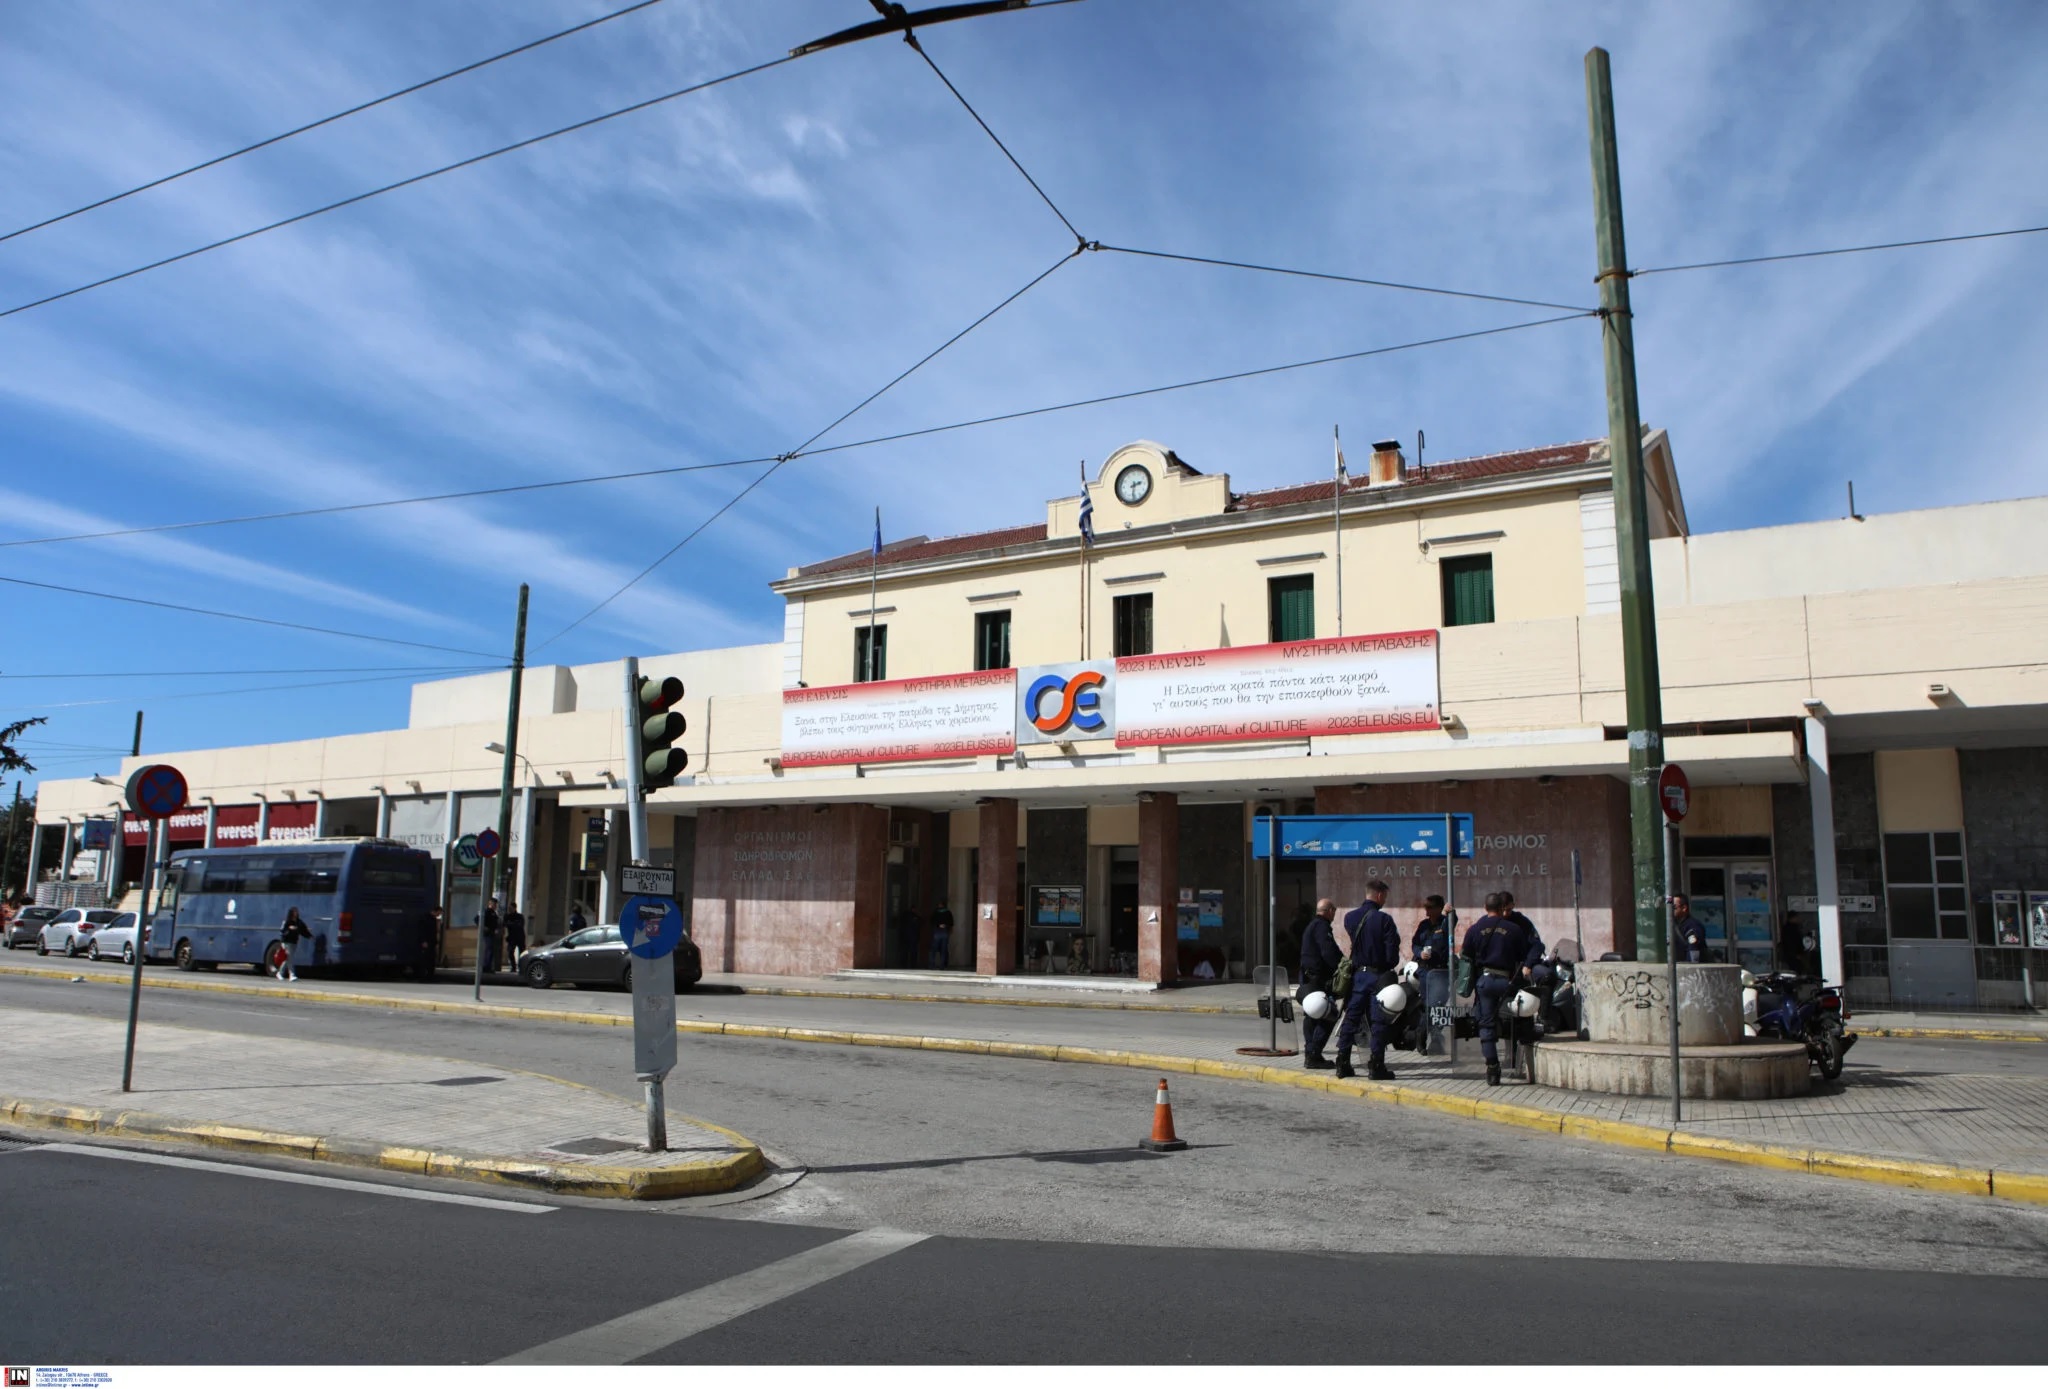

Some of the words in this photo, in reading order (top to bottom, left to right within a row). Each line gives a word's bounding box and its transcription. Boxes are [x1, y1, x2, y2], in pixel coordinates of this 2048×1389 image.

[1283, 642, 1347, 658] ΜΥΣΤΗΡΙΑ
[1351, 635, 1431, 653] ΜΕΤΑΒΑΣΗΣ
[1119, 661, 1145, 673] 2023
[904, 679, 951, 693] ΜΥΣΤΗΡΙΑ
[953, 673, 1012, 688] ΜΕΤΑΒΑΣΗΣ
[1177, 682, 1226, 695] Ελευσίνα
[1230, 679, 1264, 693] κρατά
[1270, 676, 1305, 688] πάντα
[1310, 673, 1335, 684] κάτι
[1340, 669, 1378, 684] κρυφό
[784, 693, 804, 704] 2023
[1170, 696, 1208, 709] αυτούς
[1212, 696, 1233, 706] που
[1237, 693, 1251, 703] θα
[1256, 694, 1275, 704] την
[1278, 685, 1352, 701] επισκεφθούν
[1118, 727, 1181, 741] EUROPEAN
[1184, 724, 1232, 738] CAPITAL
[1235, 723, 1247, 735] of
[1250, 719, 1308, 733] CULTURE
[1328, 711, 1434, 729] 2023ELEUSIS.EU
[782, 750, 828, 762] EUROPEAN
[830, 748, 864, 760] CAPITAL
[867, 747, 876, 757] of
[877, 744, 920, 757] CULTURE
[933, 738, 1012, 753] 2023ELEUSIS.EU
[123, 819, 150, 833] evere
[169, 812, 208, 828] everest
[216, 821, 260, 840] everest
[269, 823, 317, 840] everest
[1474, 834, 1547, 848] ΤΑΘΜΟΣ
[623, 869, 673, 882] ΕΞΑΙΡΟΥΝΤΑΙ
[1367, 866, 1421, 877] GARE
[1438, 863, 1548, 877] CENTRALE
[1431, 1017, 1455, 1026] POL
